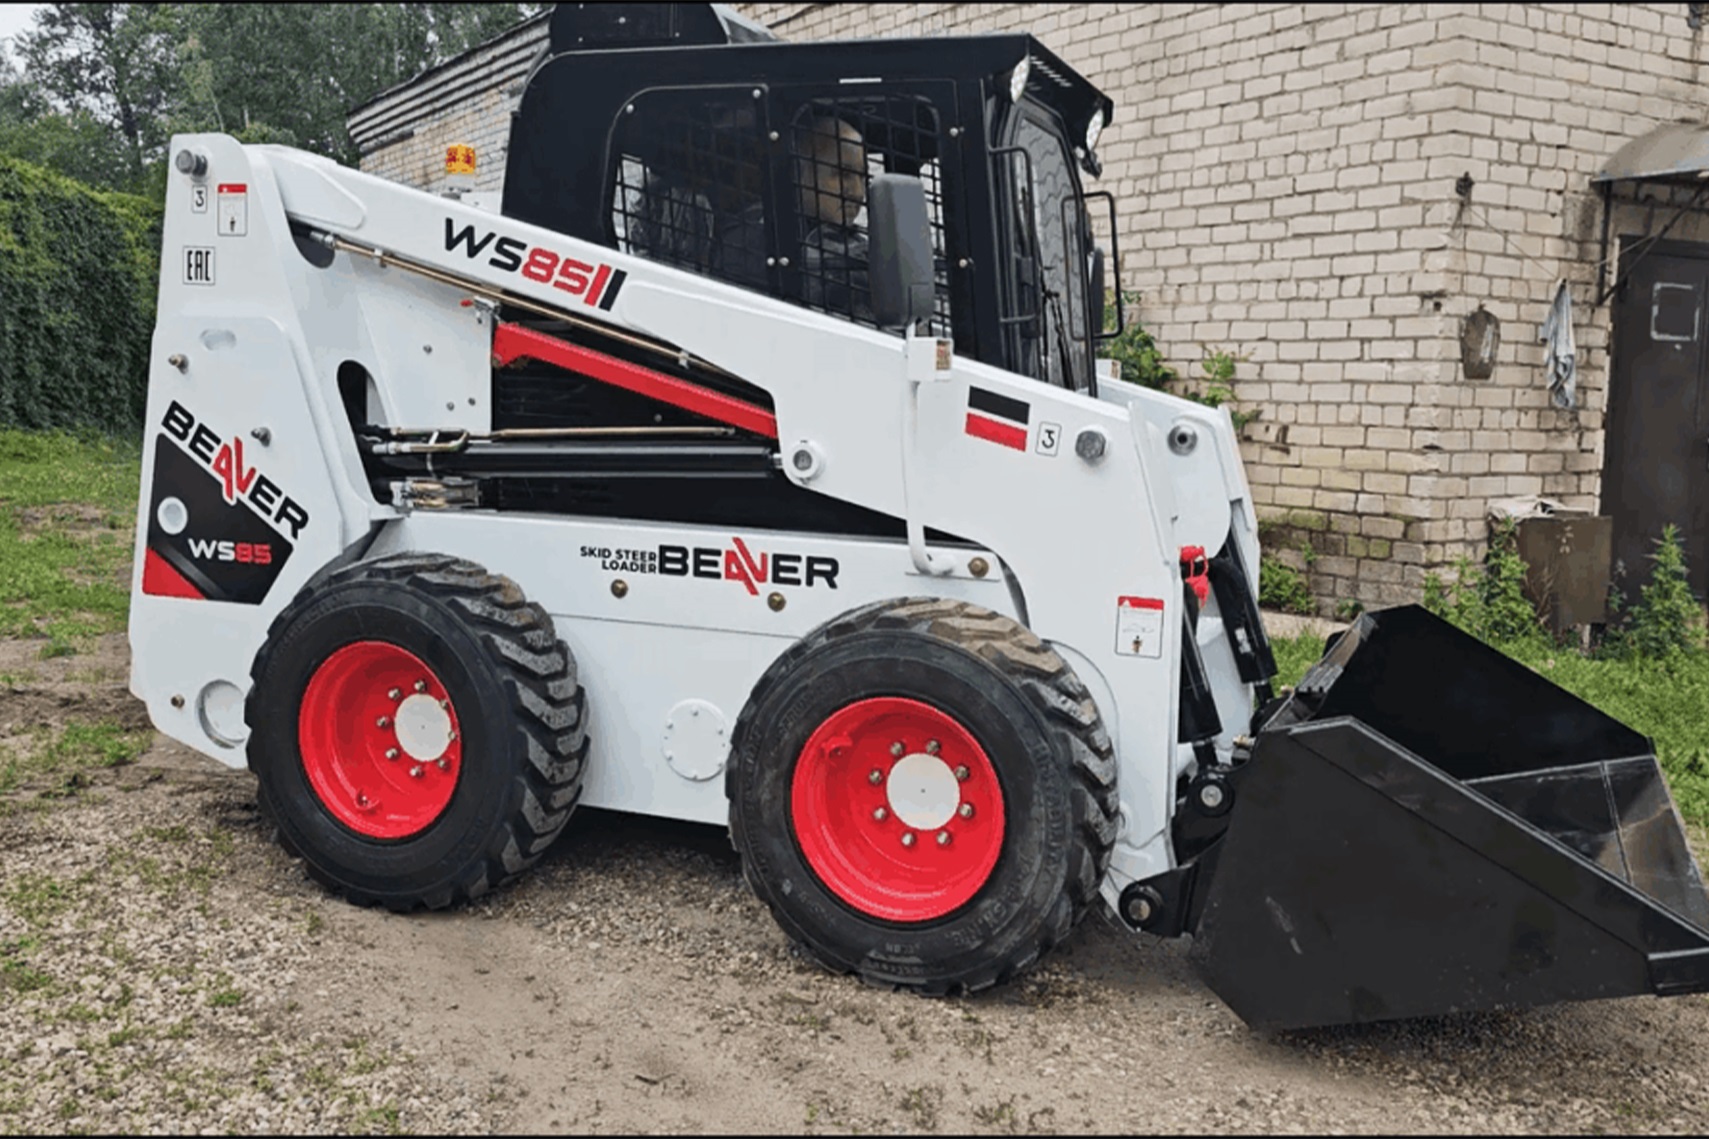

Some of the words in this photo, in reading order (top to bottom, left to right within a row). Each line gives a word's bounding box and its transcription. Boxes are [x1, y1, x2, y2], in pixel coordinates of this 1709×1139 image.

[161, 400, 309, 540] BEAVER
[187, 538, 272, 564] WS85
[580, 546, 612, 559] SKID
[615, 549, 657, 562] STEER
[658, 537, 840, 596] BEAVER
[601, 560, 657, 574] LOADER
